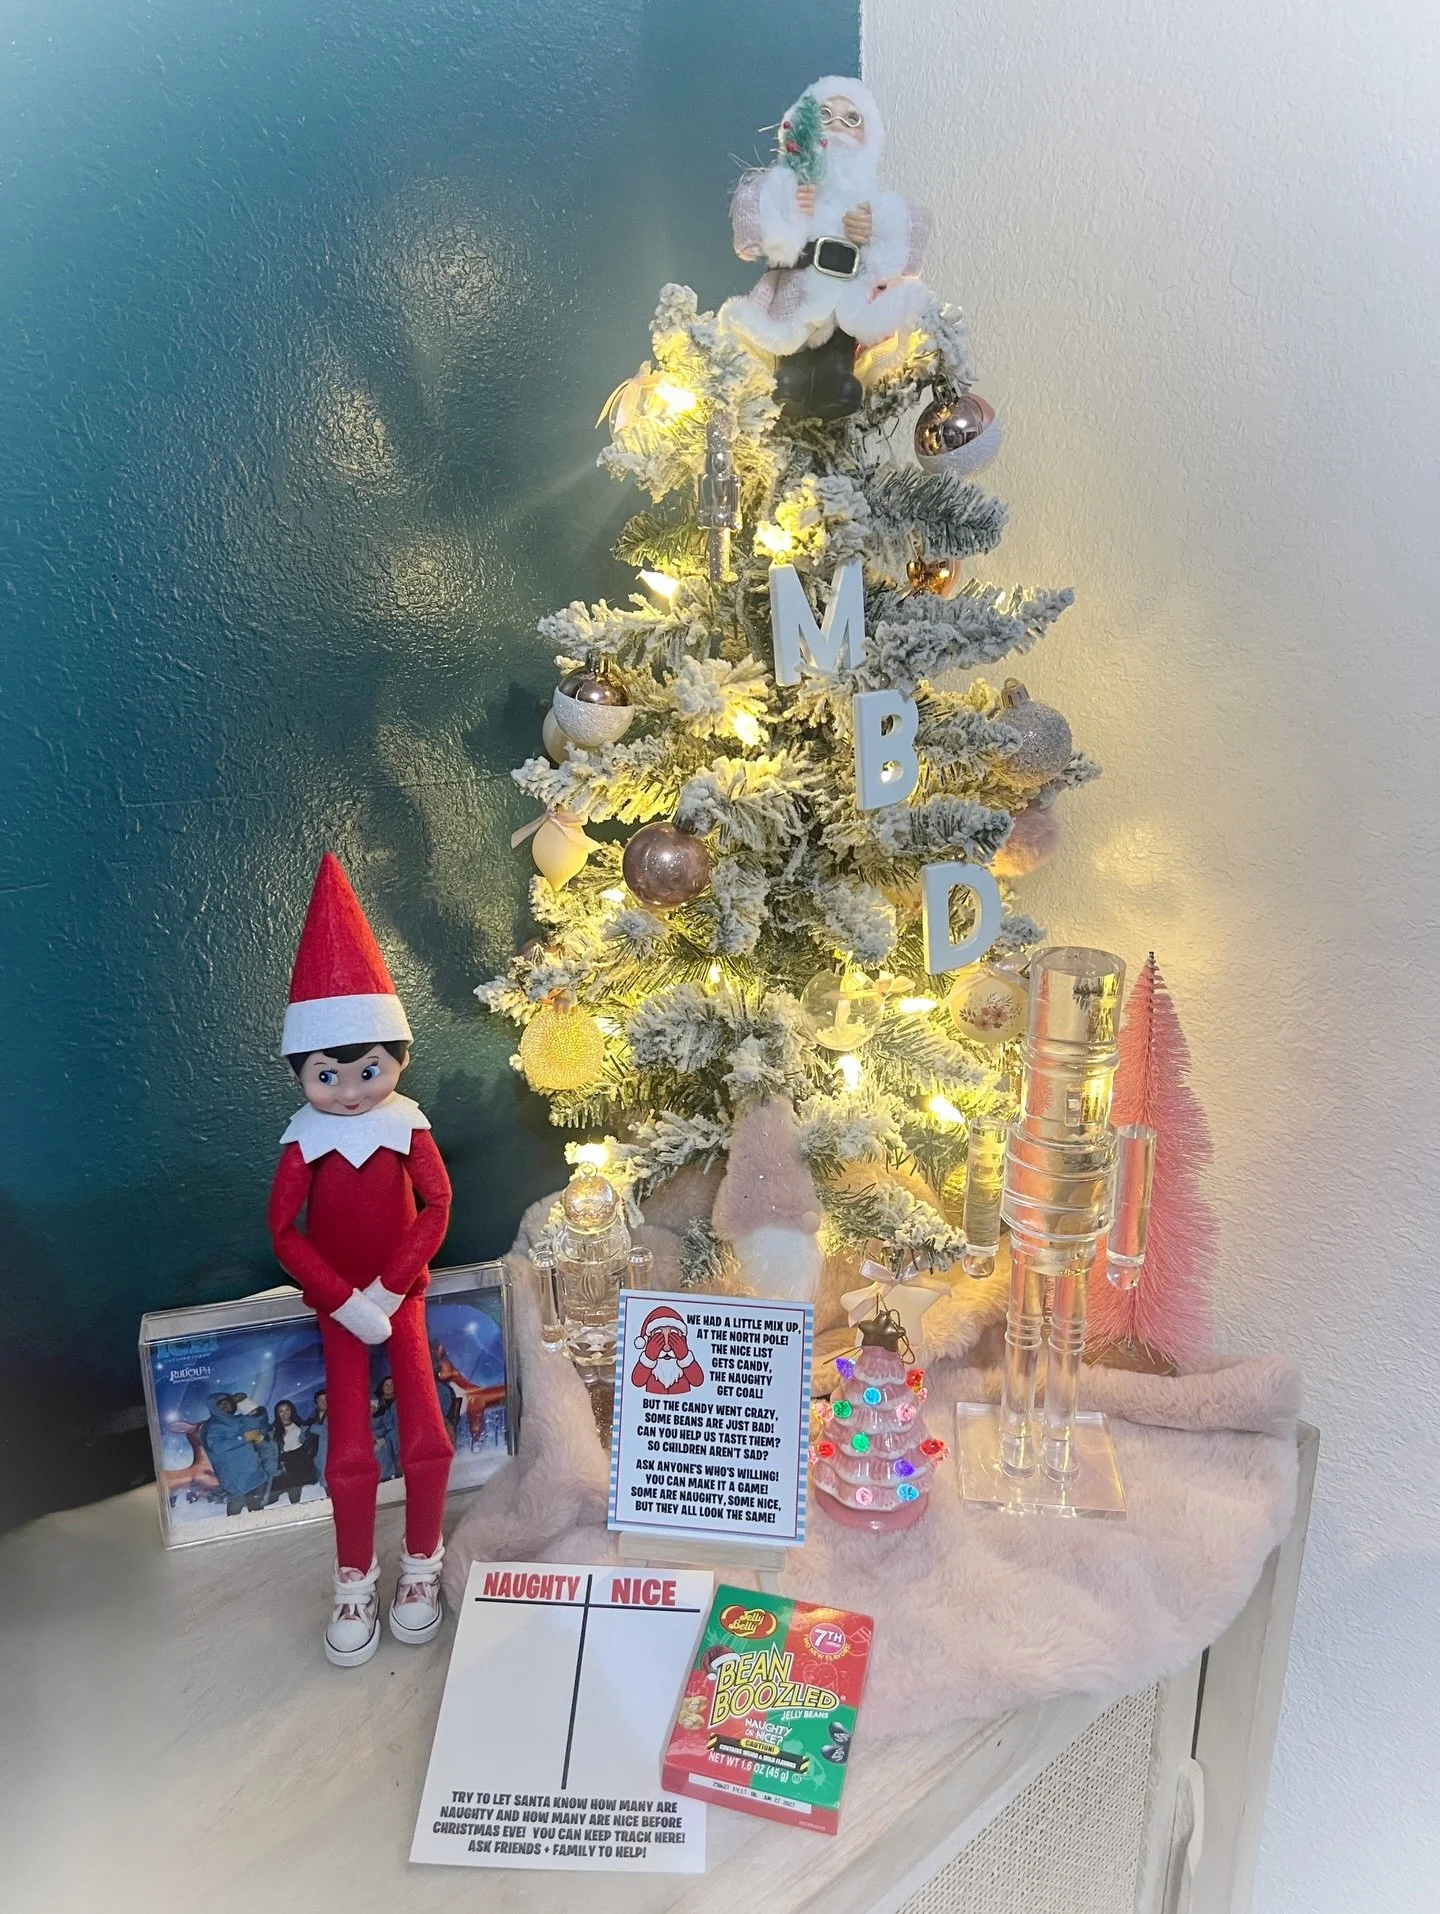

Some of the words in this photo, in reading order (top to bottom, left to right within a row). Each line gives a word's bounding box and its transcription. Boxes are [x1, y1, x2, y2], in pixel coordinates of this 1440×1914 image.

[769, 559, 866, 687] M
[853, 689, 918, 811] B
[921, 860, 1000, 975] D
[687, 1314, 700, 1325] WE
[703, 1316, 722, 1327] HAD
[724, 1317, 730, 1327] A
[733, 1318, 762, 1329] LITTLE
[764, 1321, 783, 1331] MIX
[786, 1323, 801, 1333] UP,
[697, 1330, 708, 1340] AT
[711, 1330, 727, 1341] THE
[730, 1332, 760, 1344] NORTH
[763, 1335, 788, 1345] POLE!
[711, 1344, 727, 1354] THE
[729, 1345, 750, 1356] NICE
[754, 1348, 773, 1358] LIST
[712, 1358, 734, 1369] GETS
[737, 1360, 772, 1372] CANDY,
[710, 1371, 725, 1382] THE
[728, 1373, 772, 1386] NAUGHTY
[717, 1386, 733, 1396] GET
[736, 1388, 763, 1398] COAL!
[643, 1399, 660, 1410] BUT
[663, 1401, 679, 1411] THE
[682, 1402, 713, 1414] CANDY
[716, 1405, 742, 1417] WENT
[745, 1408, 778, 1420] CRAZY,
[645, 1413, 671, 1424] SOME
[674, 1415, 703, 1427] BEANS
[706, 1418, 723, 1429] ARE
[726, 1420, 749, 1431] JUST
[752, 1422, 774, 1433] BAD!
[637, 1426, 656, 1437] CAN
[659, 1428, 677, 1439] YOU
[680, 1430, 701, 1440] HELP
[704, 1432, 716, 1441] US
[719, 1434, 747, 1444] TASTE
[749, 1436, 780, 1447] THEM?
[648, 1441, 660, 1451] SO
[662, 1442, 706, 1455] CHILDREN
[709, 1446, 740, 1458] AREN'T
[744, 1449, 768, 1460] SAD?
[636, 1459, 654, 1470] ASK
[657, 1461, 702, 1474] ANYONE'S
[705, 1465, 734, 1477] WHO'S
[738, 1468, 779, 1482] WILLING!
[646, 1474, 664, 1485] YOU
[667, 1476, 685, 1487] CAN
[688, 1478, 715, 1489] MAKE
[717, 1480, 726, 1490] IT
[729, 1481, 735, 1491] A
[738, 1482, 768, 1494] GAME!
[631, 1487, 657, 1498] SOME
[660, 1489, 677, 1500] ARE
[680, 1491, 726, 1505] NAUGHTY,
[728, 1495, 754, 1507] SOME
[757, 1498, 781, 1511] NICE,
[636, 1501, 653, 1511] BUT
[656, 1503, 678, 1514] THEY
[681, 1505, 696, 1516] ALL
[700, 1507, 723, 1518] LOOK
[726, 1509, 743, 1520] THE
[745, 1511, 775, 1523] SAME!
[483, 1572, 581, 1601] NAUGHTY
[611, 1578, 677, 1606] NICE
[740, 1609, 764, 1624] Jelly
[729, 1620, 757, 1635] Belly
[717, 1643, 794, 1692] BEAN
[709, 1682, 839, 1728] BOOZLED
[781, 1710, 802, 1721] JELLY
[804, 1711, 828, 1719] BEANS
[745, 1718, 792, 1736] NAUGHTY
[745, 1740, 775, 1753] CAUTION!
[756, 1730, 783, 1745] NICE?
[708, 1752, 726, 1764] NET
[727, 1756, 740, 1767] WT
[741, 1760, 752, 1771] 1.6
[754, 1763, 765, 1774] OZ
[766, 1766, 779, 1778] (45
[780, 1770, 789, 1783] g)
[452, 1791, 473, 1803] TRY
[477, 1792, 490, 1804] TO
[493, 1793, 511, 1805] LET
[514, 1795, 550, 1808] SANTA
[553, 1797, 587, 1810] KNOW
[590, 1799, 616, 1810] HOW
[619, 1800, 653, 1812] MANY
[656, 1801, 677, 1813] ARE
[440, 1806, 493, 1821] NAUGHTY
[496, 1809, 519, 1822] AND
[522, 1811, 549, 1823] HOW
[552, 1812, 586, 1825] MANY
[589, 1814, 610, 1826] ARE
[613, 1815, 638, 1827] NICE
[642, 1816, 682, 1828] BEFORE
[433, 1822, 500, 1837] CHRISTMAS
[503, 1826, 526, 1838] EVE!
[533, 1827, 555, 1839] YOU
[558, 1828, 581, 1840] CAN
[584, 1829, 611, 1841] KEEP
[614, 1830, 651, 1843] TRACK
[655, 1831, 685, 1843] HERE!
[468, 1840, 491, 1853] ASK
[494, 1841, 541, 1855] FRIENDS
[553, 1844, 595, 1857] FAMILY
[598, 1846, 612, 1858] TO
[616, 1846, 646, 1858] HELP!
